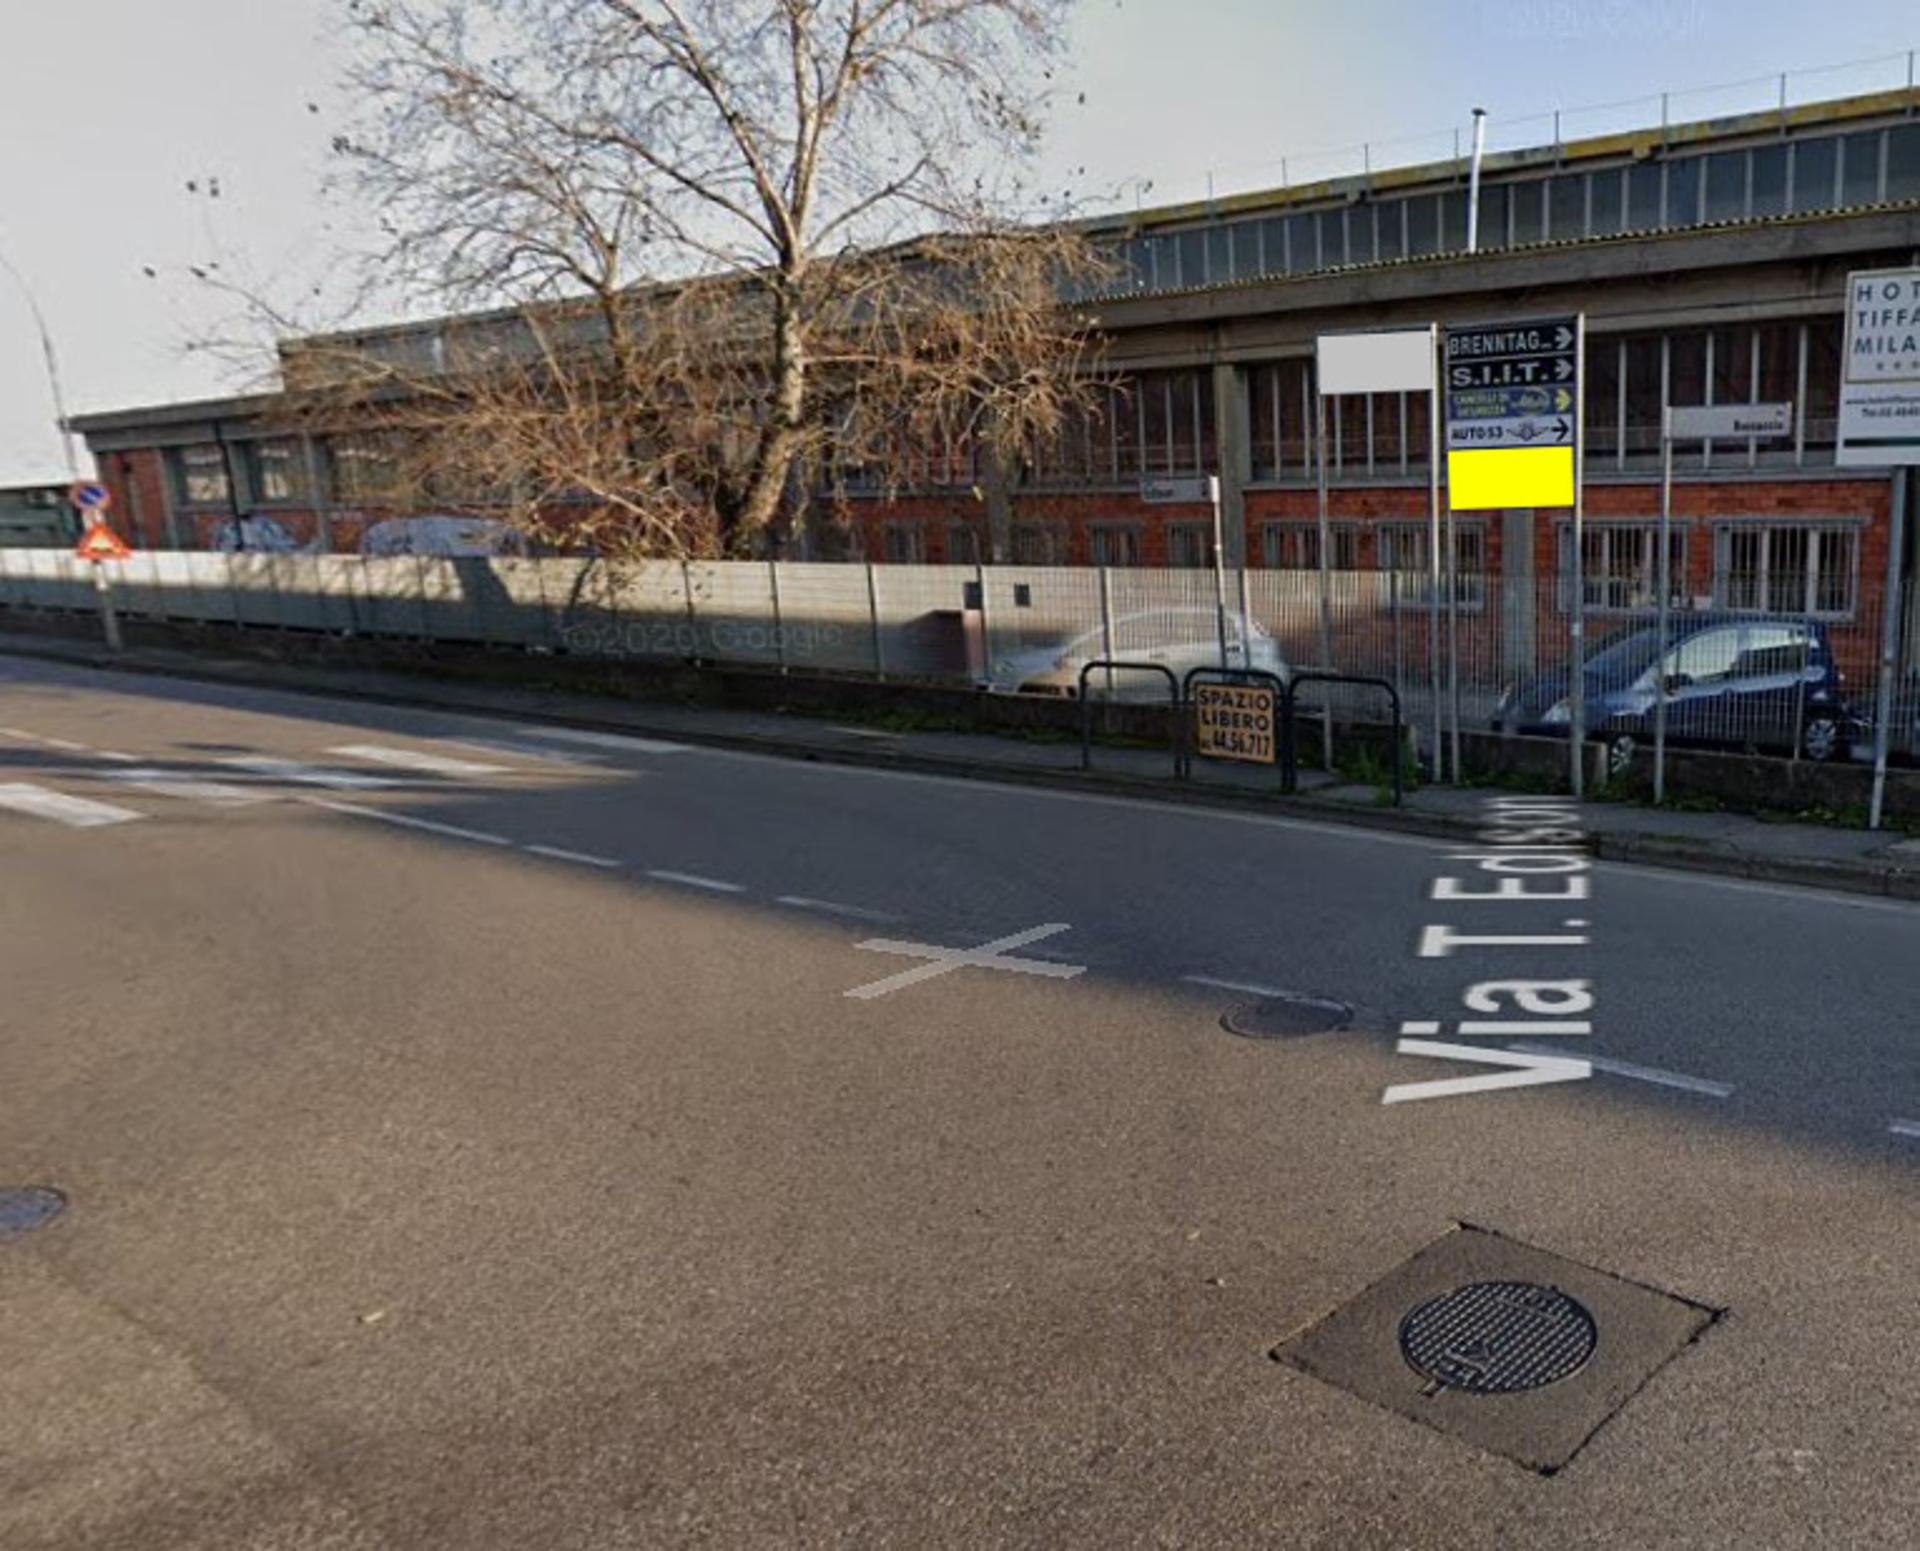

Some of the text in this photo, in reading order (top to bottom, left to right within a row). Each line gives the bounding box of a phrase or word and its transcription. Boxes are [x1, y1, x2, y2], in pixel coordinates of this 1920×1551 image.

[1450, 330, 1540, 356] BRENNTAG
[1452, 361, 1549, 387] S.I.I.T.
[1199, 689, 1270, 711] SPAZIO
[1201, 708, 1269, 732] LIBERO
